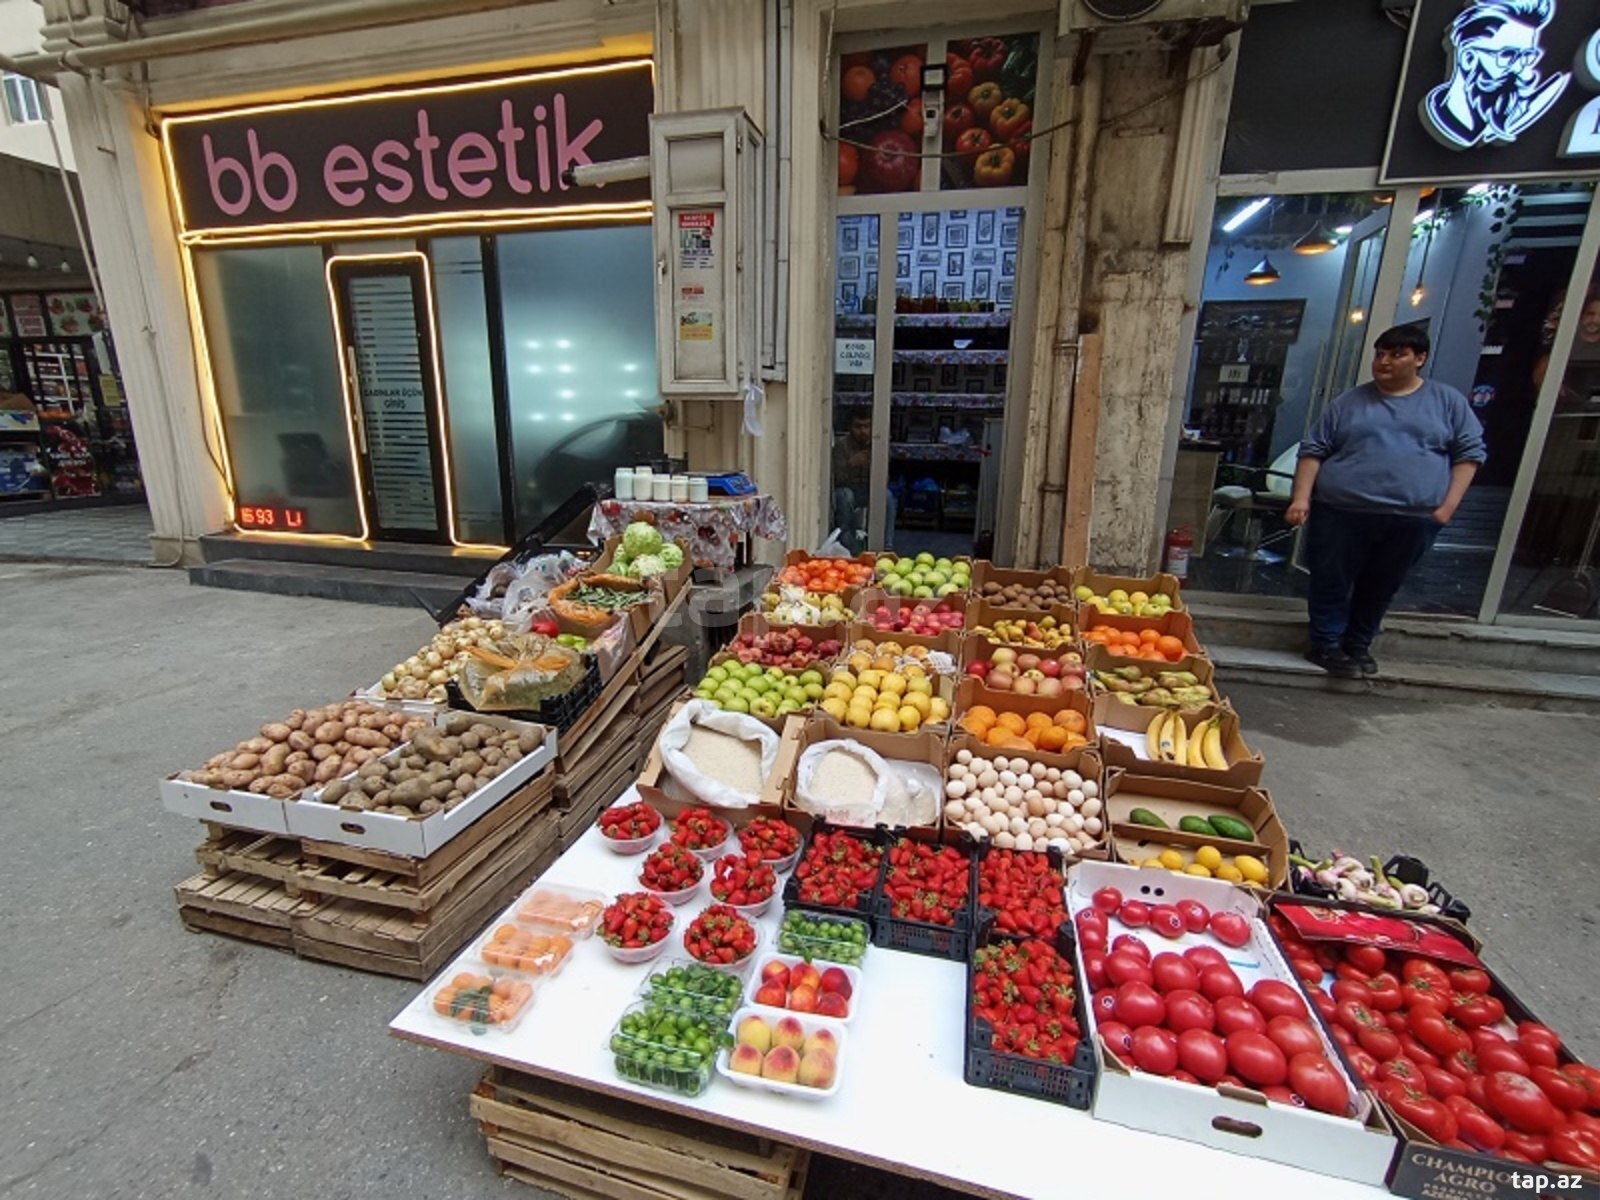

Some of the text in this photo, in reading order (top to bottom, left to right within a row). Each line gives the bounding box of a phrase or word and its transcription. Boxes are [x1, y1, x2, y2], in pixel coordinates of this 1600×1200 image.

[203, 93, 603, 216] bb estetik
[1411, 1153, 1514, 1184] CHAMPIO
[1433, 1172, 1497, 1194] AGRO
